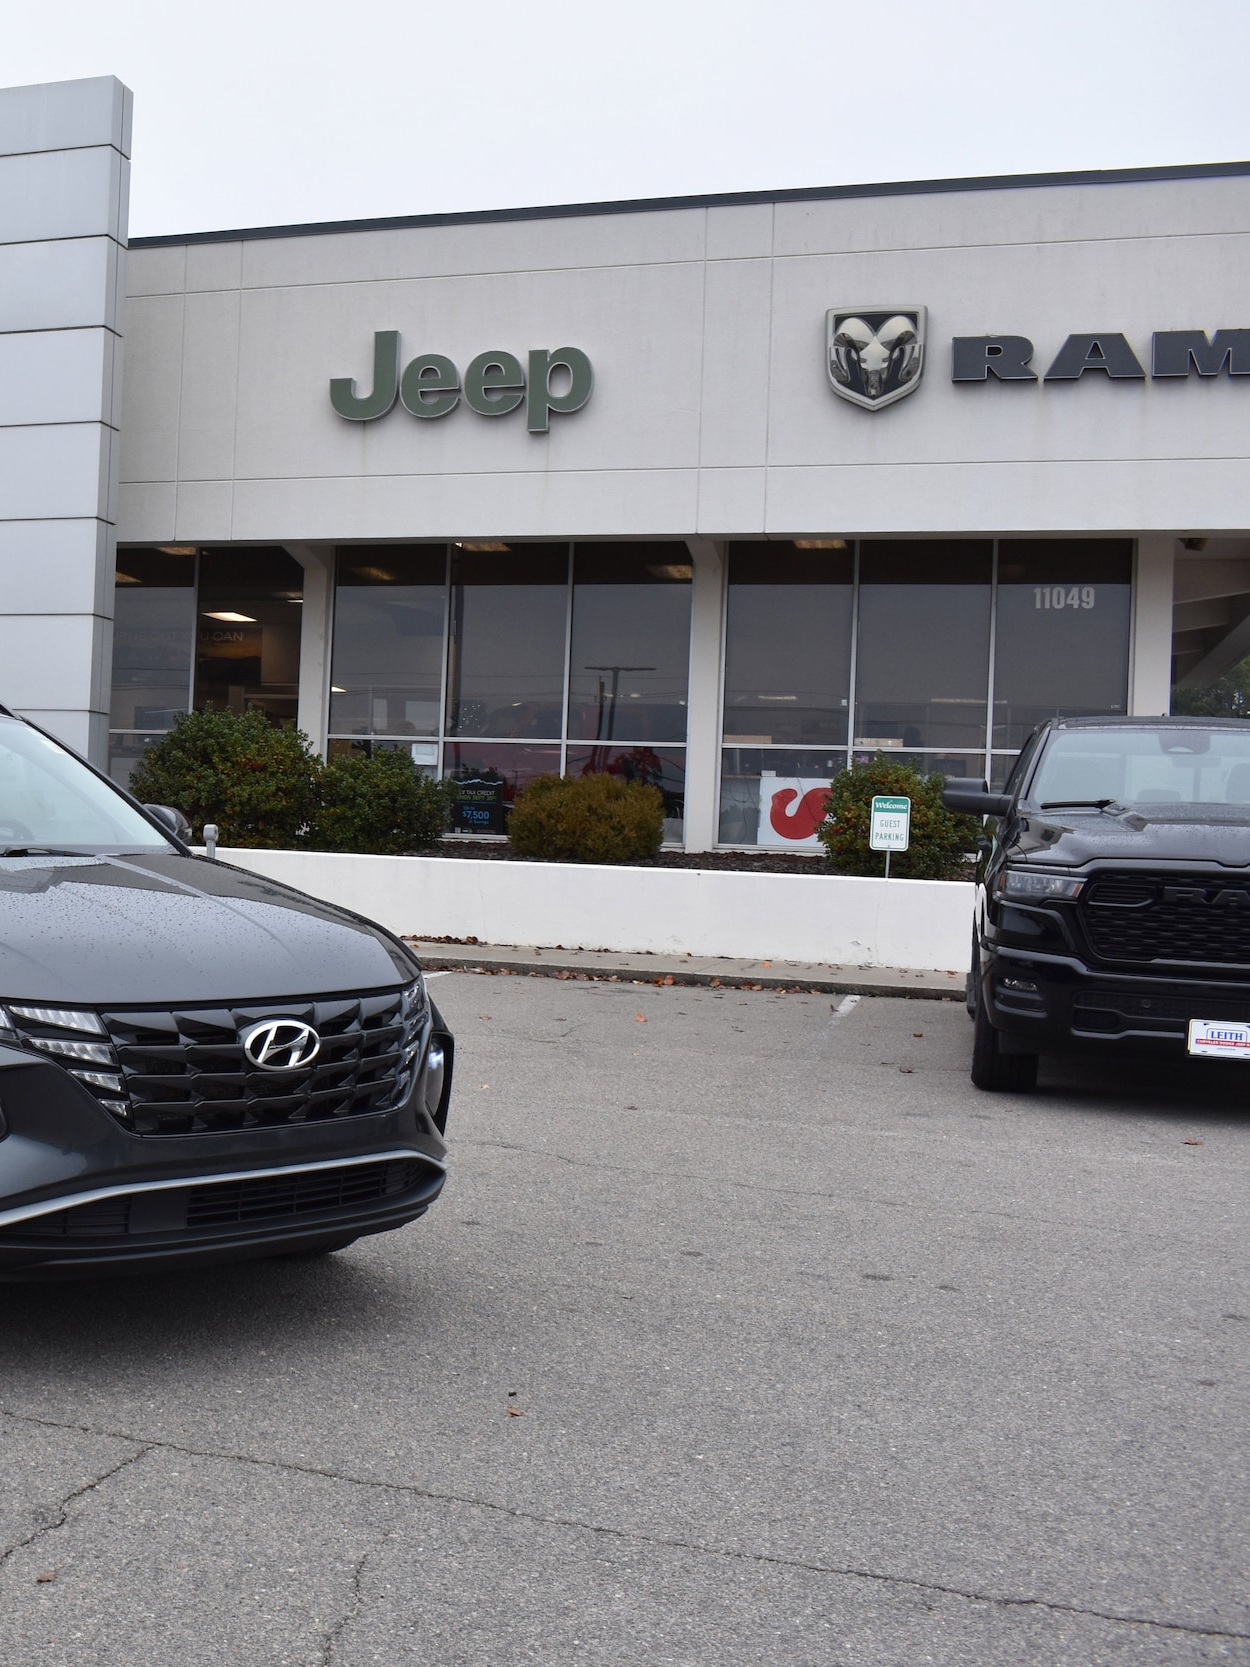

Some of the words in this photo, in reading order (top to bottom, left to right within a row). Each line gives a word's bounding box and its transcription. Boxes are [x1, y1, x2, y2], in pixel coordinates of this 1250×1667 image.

[951, 327, 1250, 383] RAM
[329, 330, 595, 433] Jeep
[1033, 586, 1095, 609] 11049
[212, 631, 244, 641] CAN
[875, 801, 907, 810] Welcome
[462, 811, 490, 819] $7,500
[880, 819, 901, 828] GUEST
[875, 832, 904, 842] PARKING
[1211, 1031, 1243, 1040] LEITH
